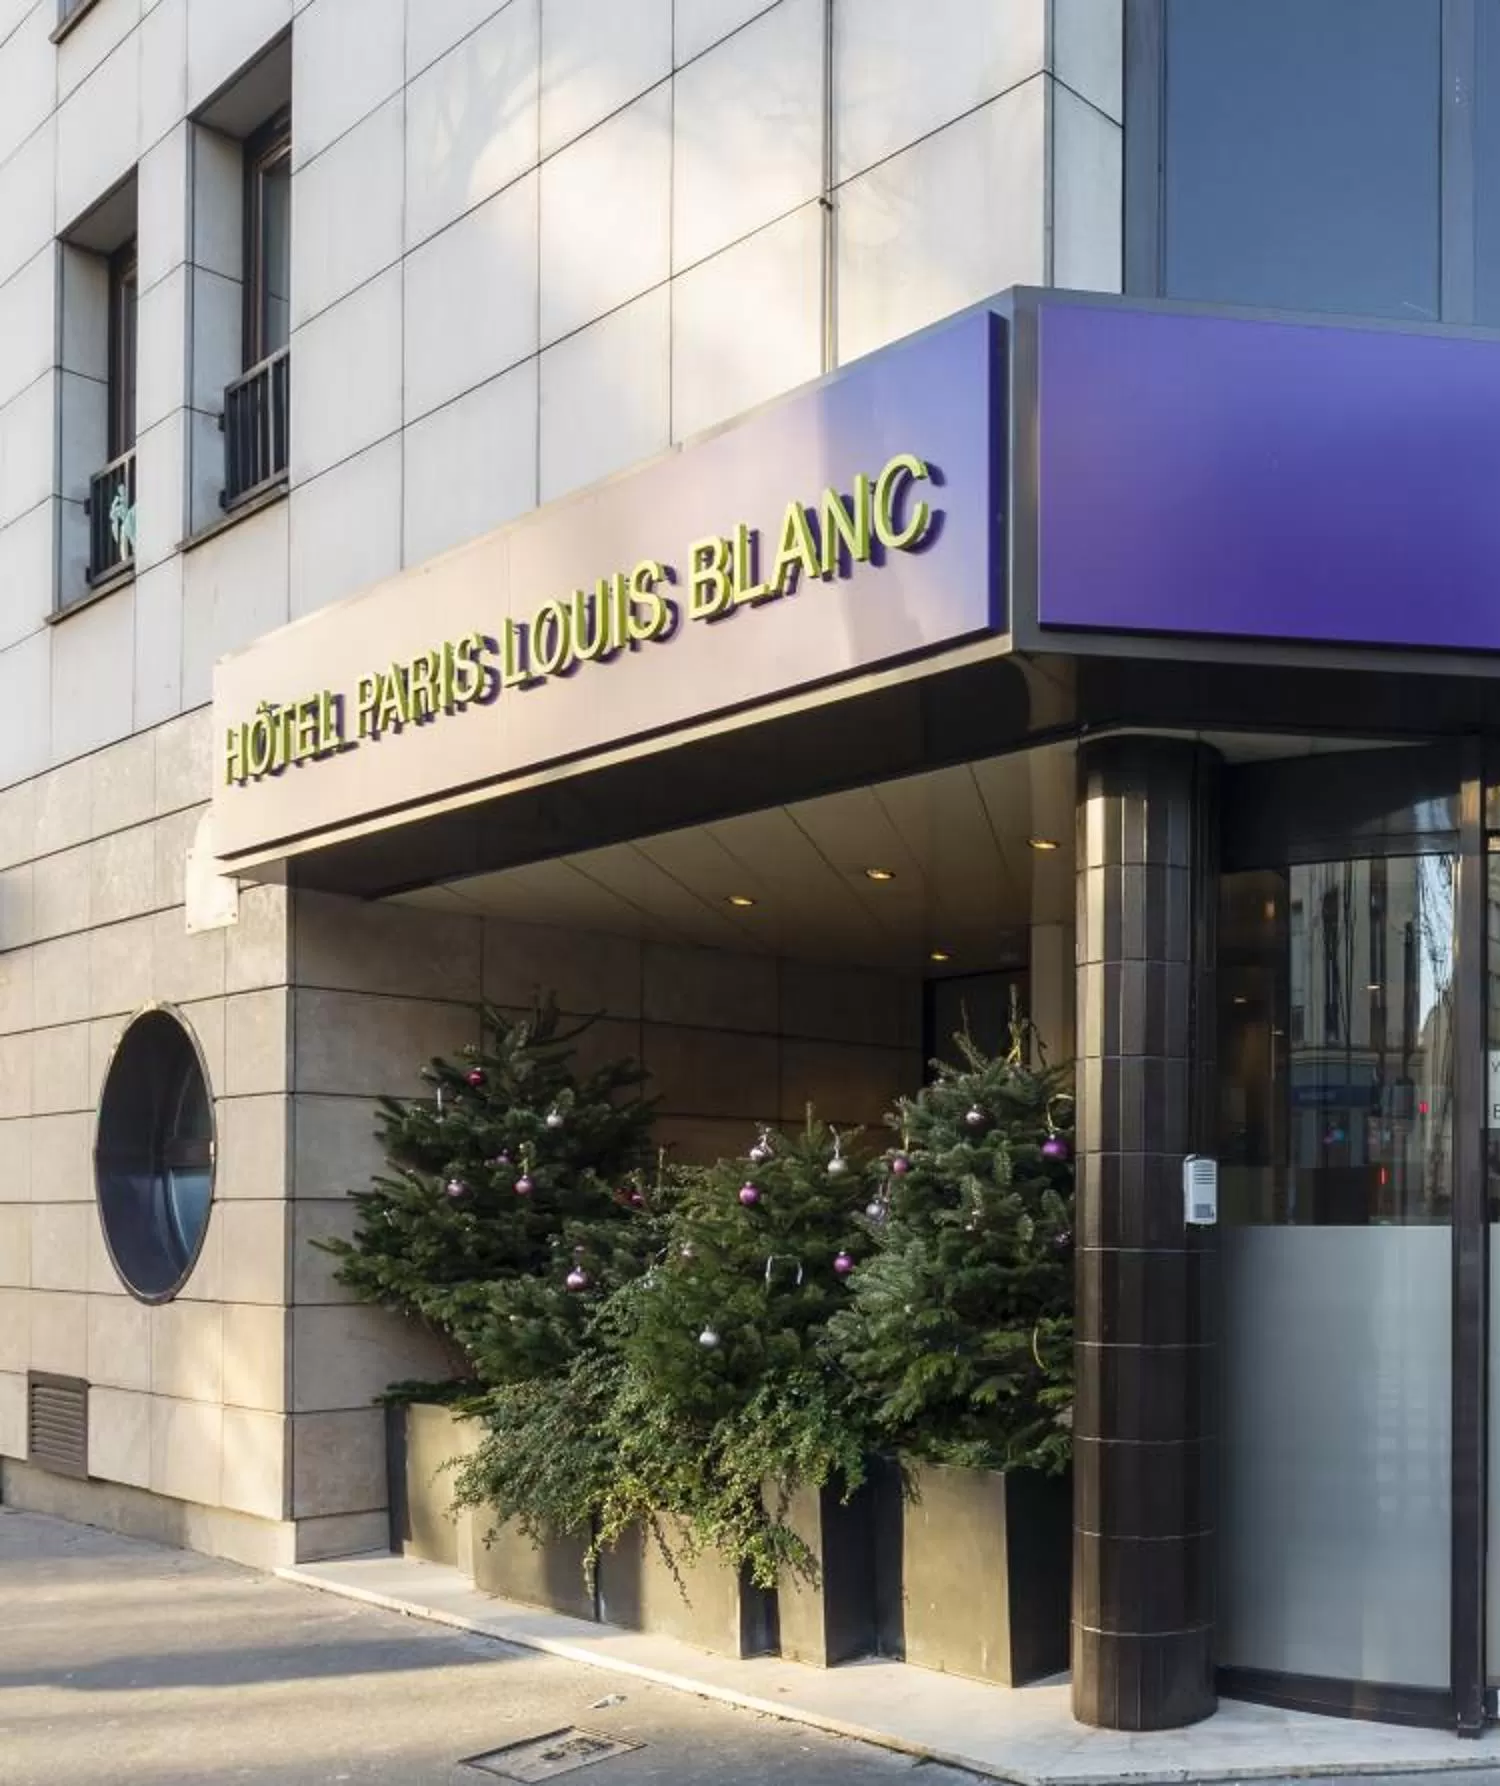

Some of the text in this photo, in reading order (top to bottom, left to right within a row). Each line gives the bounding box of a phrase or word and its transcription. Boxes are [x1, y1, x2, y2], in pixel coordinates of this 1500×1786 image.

[224, 453, 933, 786] HÔTEL PARIS LOUIS BLANC
